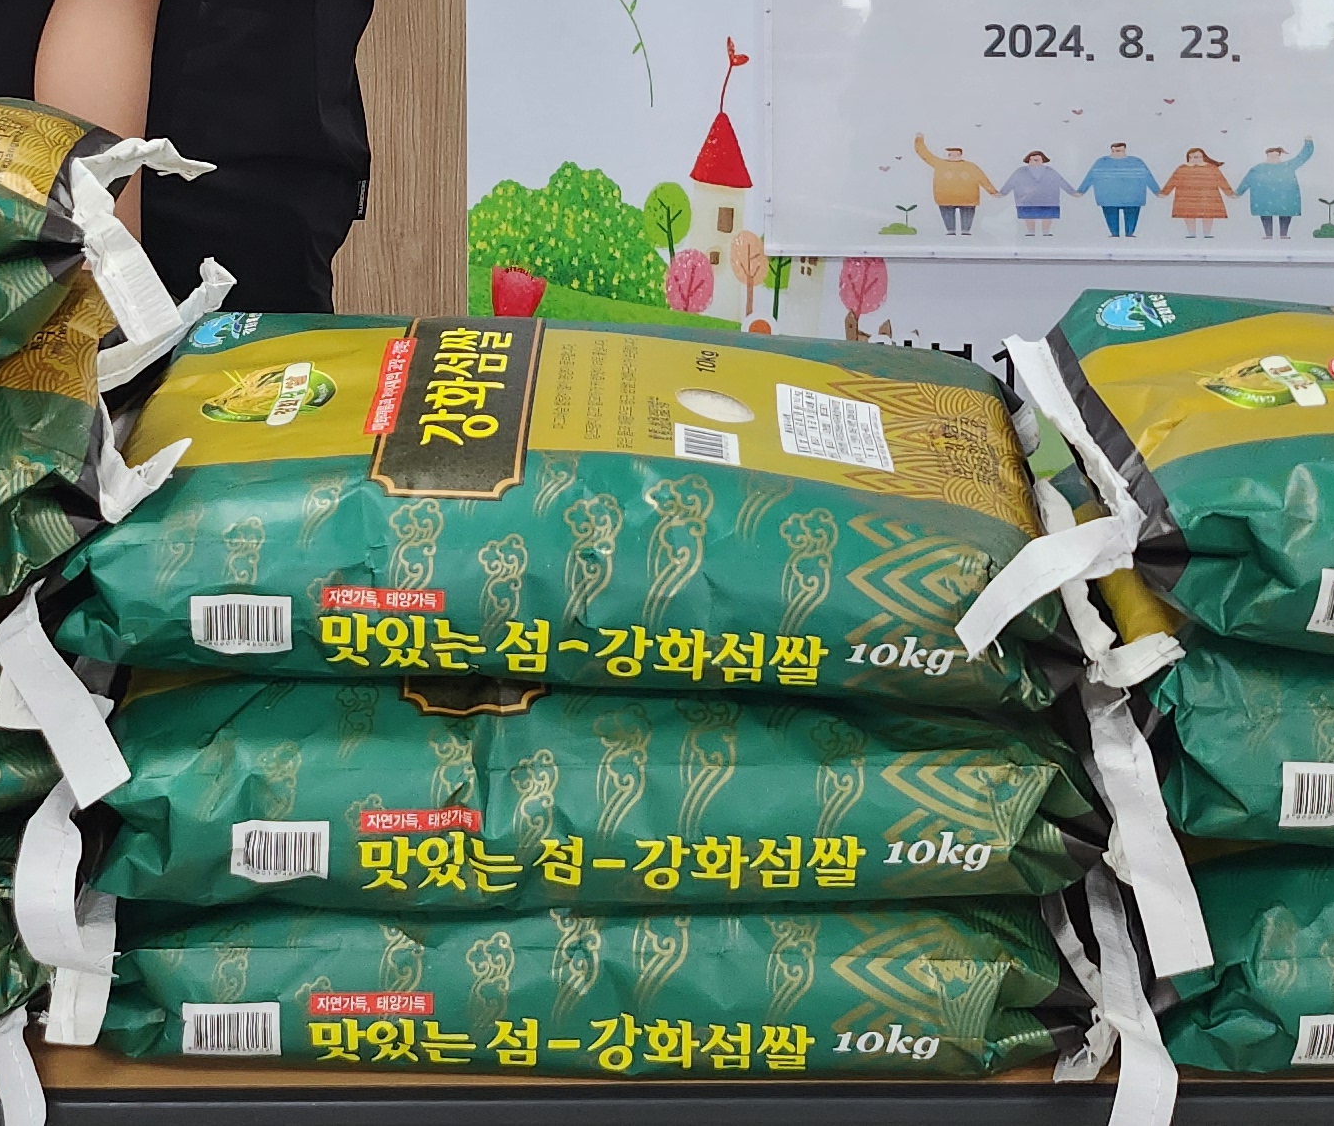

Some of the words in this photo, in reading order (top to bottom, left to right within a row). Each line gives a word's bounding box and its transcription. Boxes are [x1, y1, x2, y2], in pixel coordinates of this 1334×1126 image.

[984, 24, 1096, 63] 2024.
[1119, 24, 1155, 63] 8.
[1180, 24, 1241, 63] 23.
[419, 328, 513, 447] 강화섬쌀
[327, 588, 381, 610] 자연가득,
[386, 590, 438, 610] 태양가득
[319, 612, 485, 670] 맛있는
[496, 618, 829, 687] 섬-강화섬쌀
[845, 636, 955, 676] 10kg
[428, 810, 475, 829] 태양가득
[358, 831, 524, 893] 맛있는
[532, 834, 866, 891] 섬-강화섬쌀
[883, 831, 993, 873] 10kg
[375, 994, 427, 1013] 태양가득
[307, 1017, 477, 1064] 맛있는
[485, 1011, 816, 1072] 섬-강화섬쌀
[832, 1023, 940, 1060] 10kg
